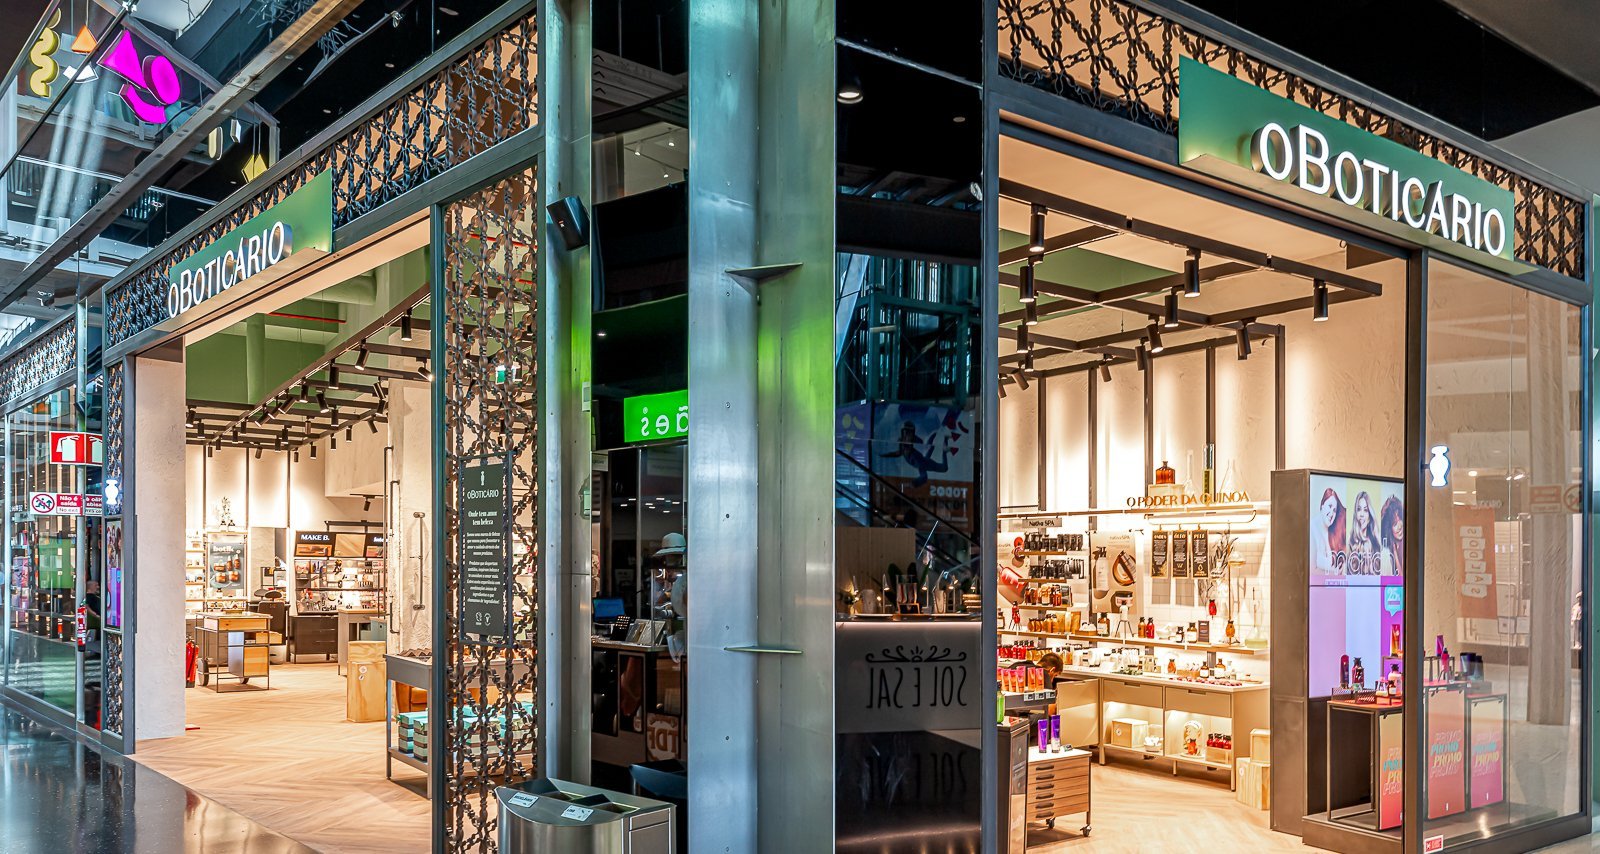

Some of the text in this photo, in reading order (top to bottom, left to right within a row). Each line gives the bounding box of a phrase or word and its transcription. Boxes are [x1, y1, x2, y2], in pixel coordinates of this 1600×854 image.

[1126, 490, 1250, 507] O PODER DA QUINOA
[1432, 751, 1462, 769] PROMO
